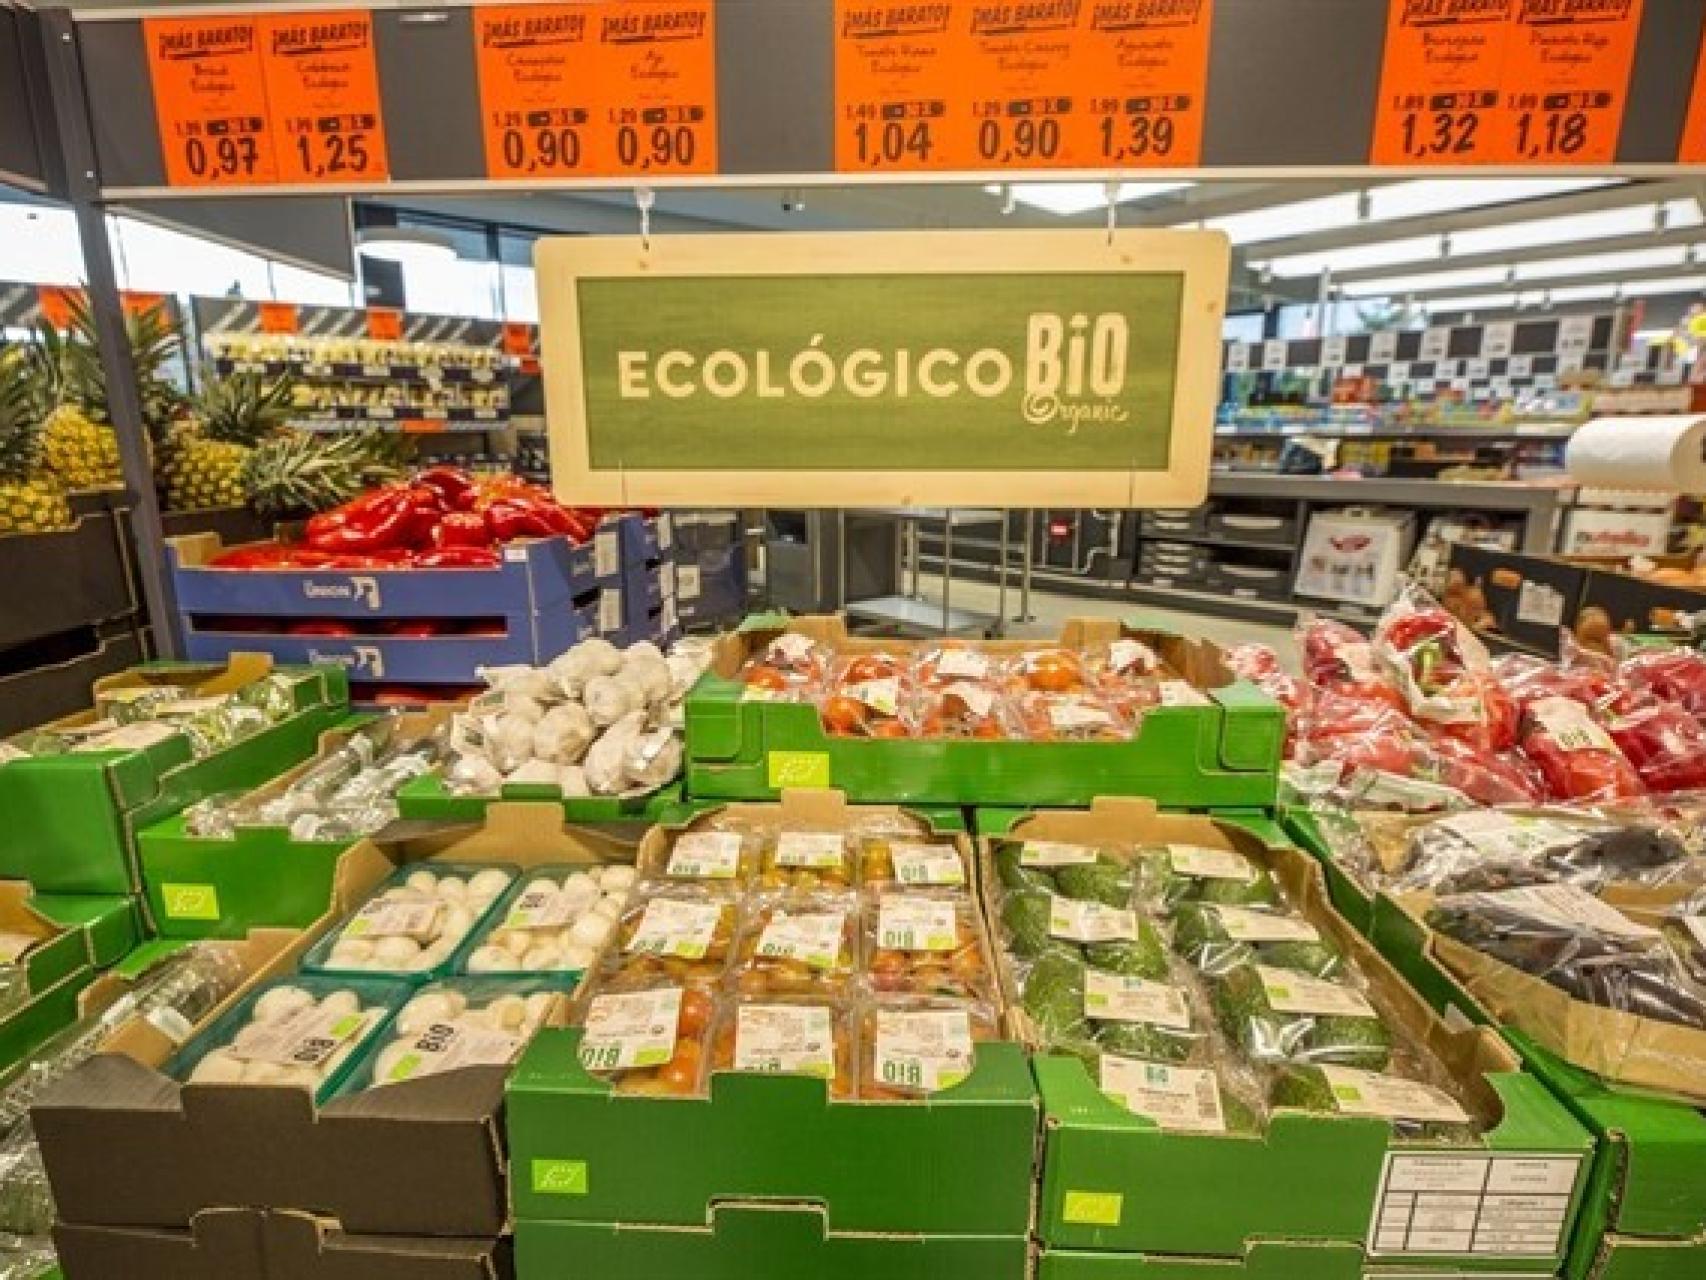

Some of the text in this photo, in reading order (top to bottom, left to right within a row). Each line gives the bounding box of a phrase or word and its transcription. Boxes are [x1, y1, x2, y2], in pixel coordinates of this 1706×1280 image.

[297, 135, 368, 176] 1,25
[504, 128, 580, 171] 0,90
[618, 126, 694, 168] 0,90
[855, 122, 931, 166] 1,04
[979, 119, 1059, 163] 0,90
[1100, 116, 1174, 160] 1,39
[1402, 113, 1479, 157] 1,32
[1518, 112, 1587, 158] 1,18
[186, 137, 259, 179] 0,97
[618, 334, 1012, 398] ECOLÓGICO
[1023, 394, 1130, 434] Organic
